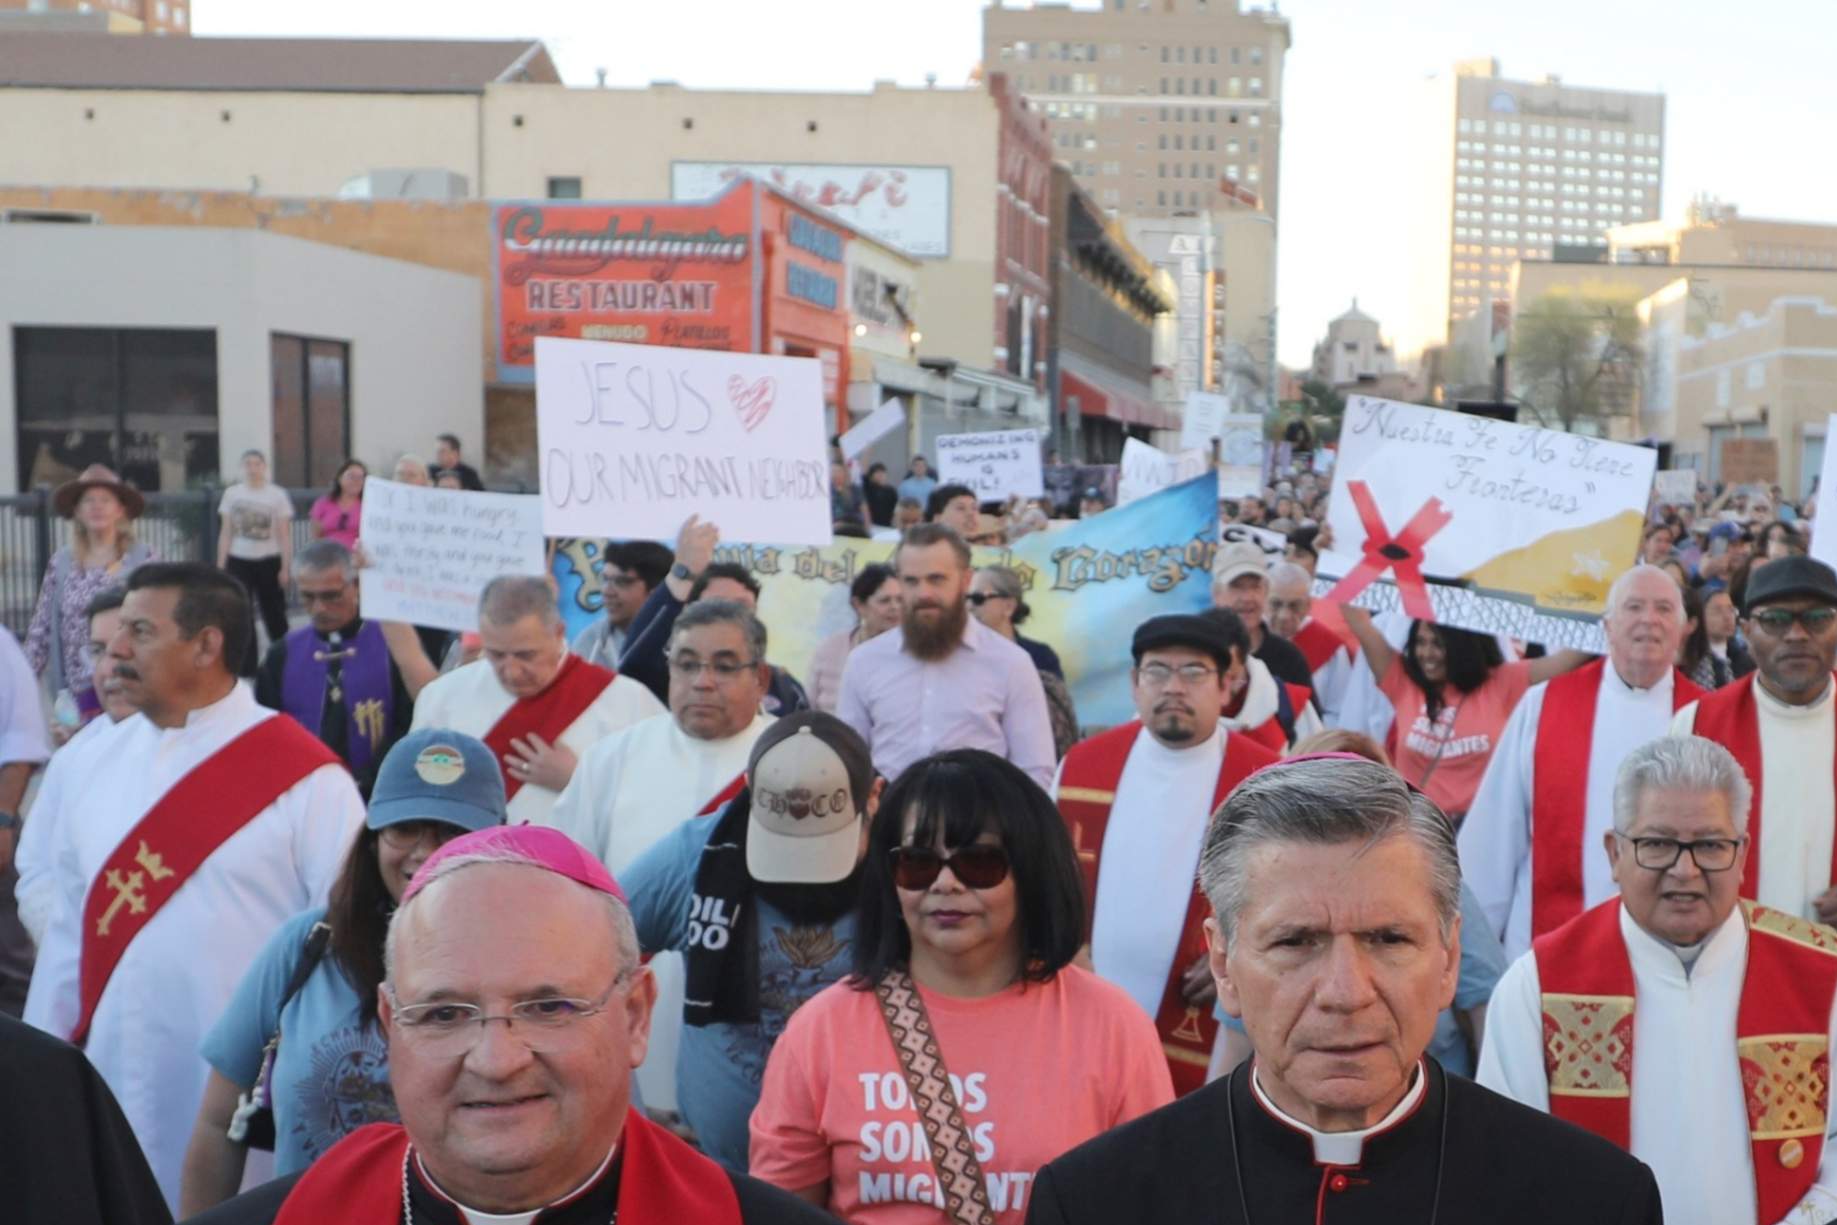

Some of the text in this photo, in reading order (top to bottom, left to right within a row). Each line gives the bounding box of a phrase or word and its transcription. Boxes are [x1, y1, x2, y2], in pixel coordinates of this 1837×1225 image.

[528, 280, 716, 313] RESTAURANT
[575, 361, 712, 434] JESUS
[547, 448, 614, 508] OUR
[618, 453, 743, 499] MIGRANT
